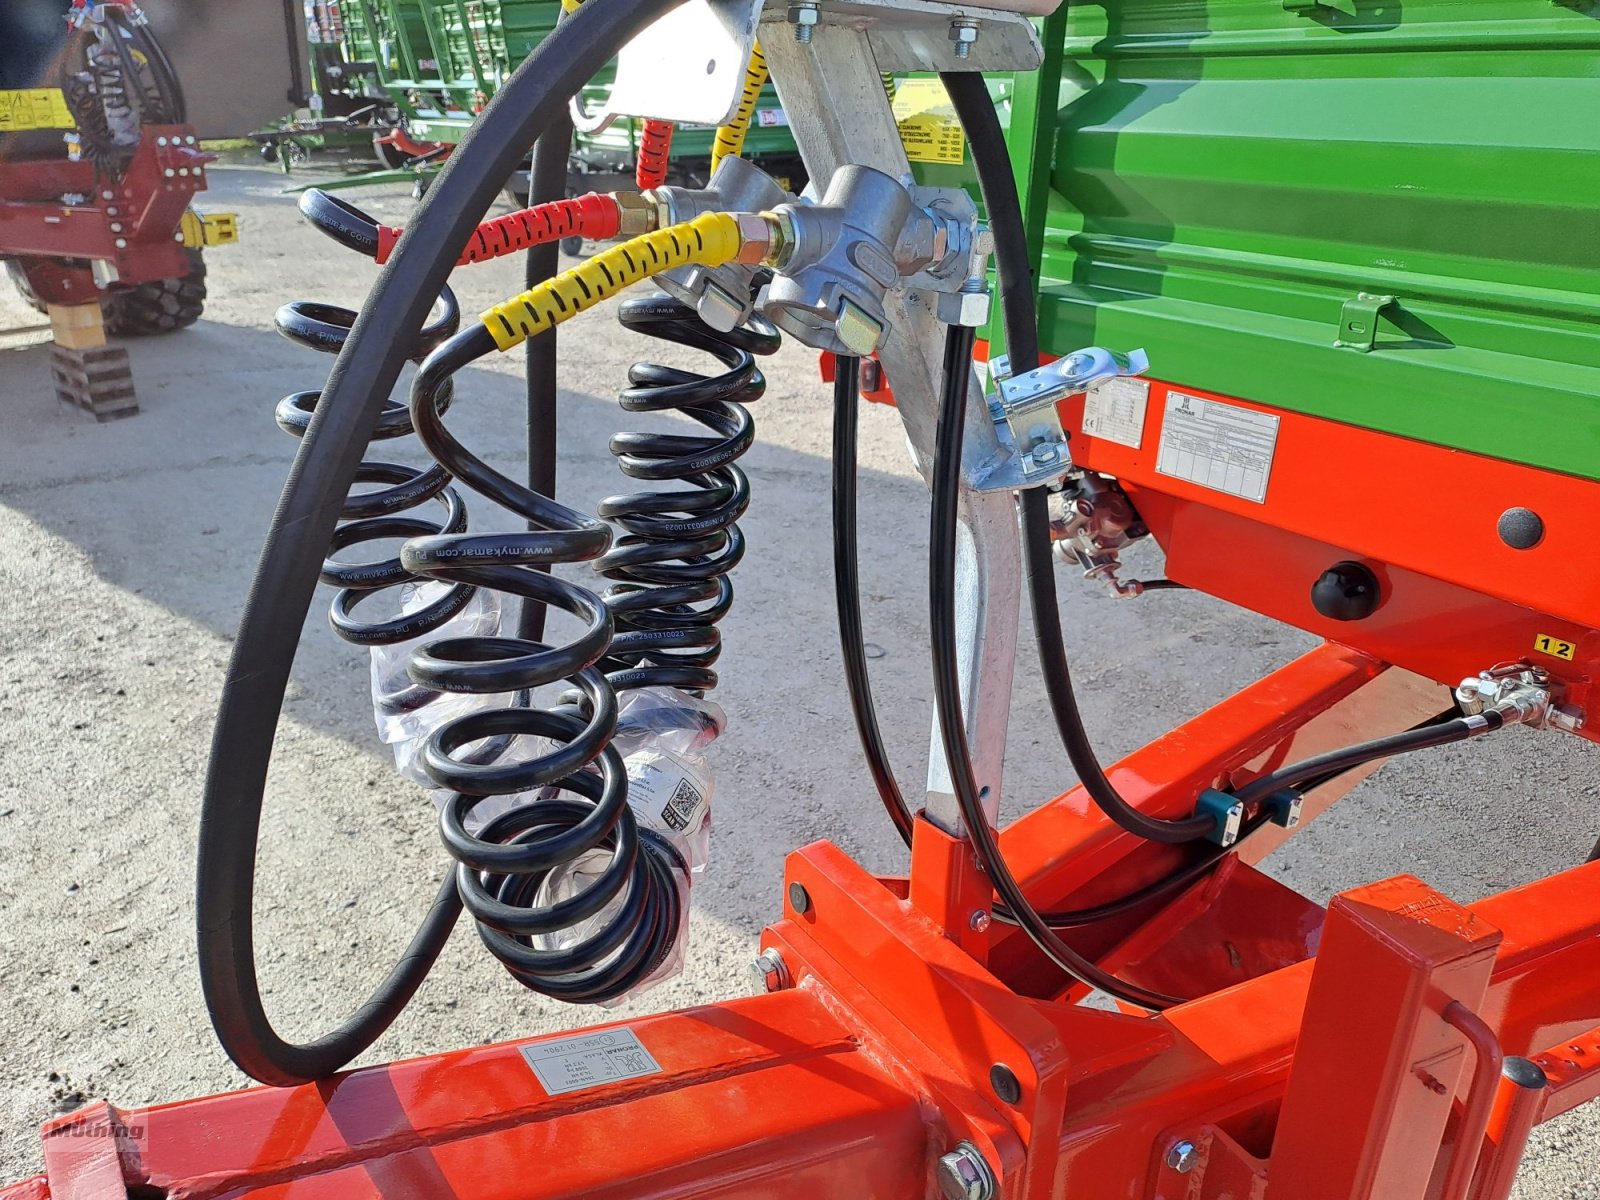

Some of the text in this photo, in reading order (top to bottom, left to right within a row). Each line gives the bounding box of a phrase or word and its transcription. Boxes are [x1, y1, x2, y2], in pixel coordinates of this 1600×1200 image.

[1175, 407, 1195, 416] PRONAR
[416, 550, 427, 560] PU
[436, 545, 553, 558] www.mykamar.com
[543, 1046, 566, 1055] 2904
[606, 1044, 639, 1055] PRONAR
